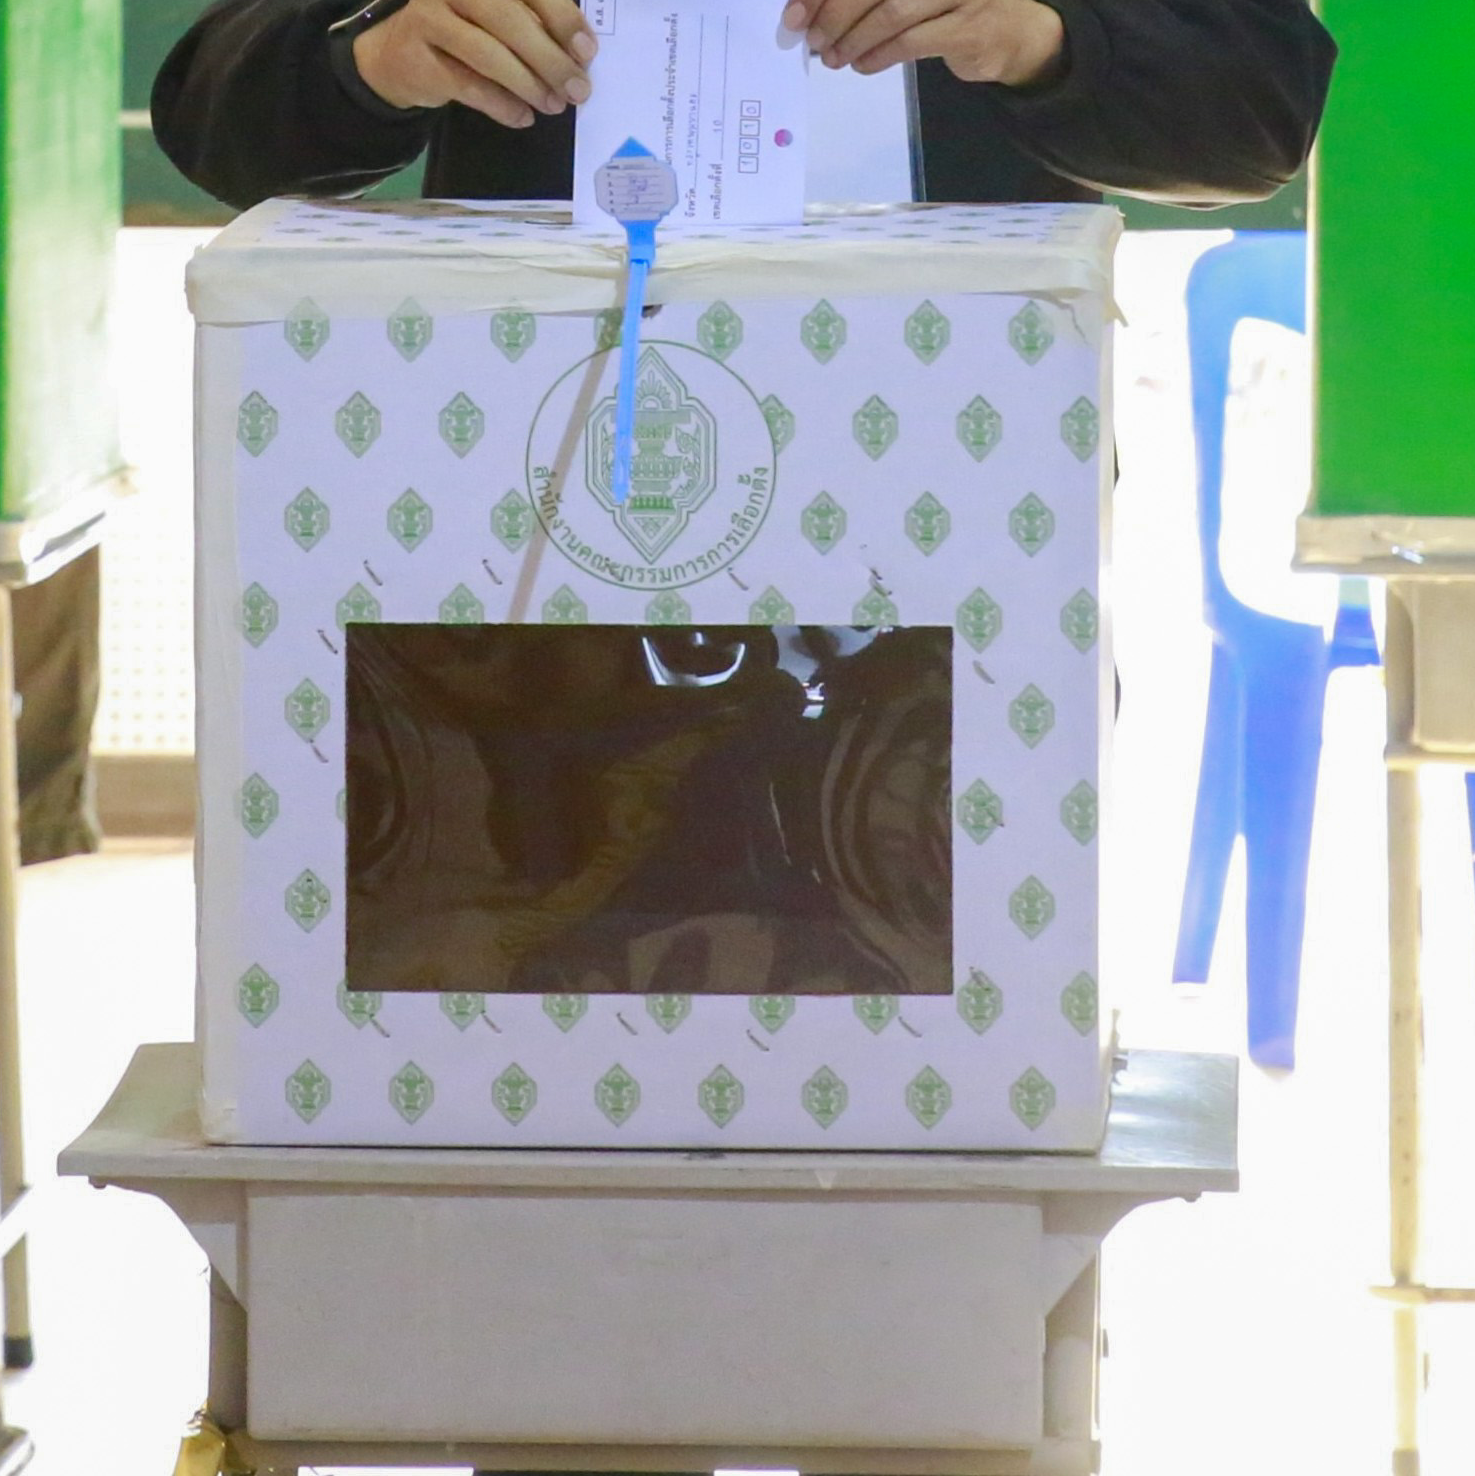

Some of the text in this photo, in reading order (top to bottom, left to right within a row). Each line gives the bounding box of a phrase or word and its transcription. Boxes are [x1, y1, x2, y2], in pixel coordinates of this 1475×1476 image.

[532, 464, 770, 585] สำนักงานคณะกรรมการการเลือกตั้ง
